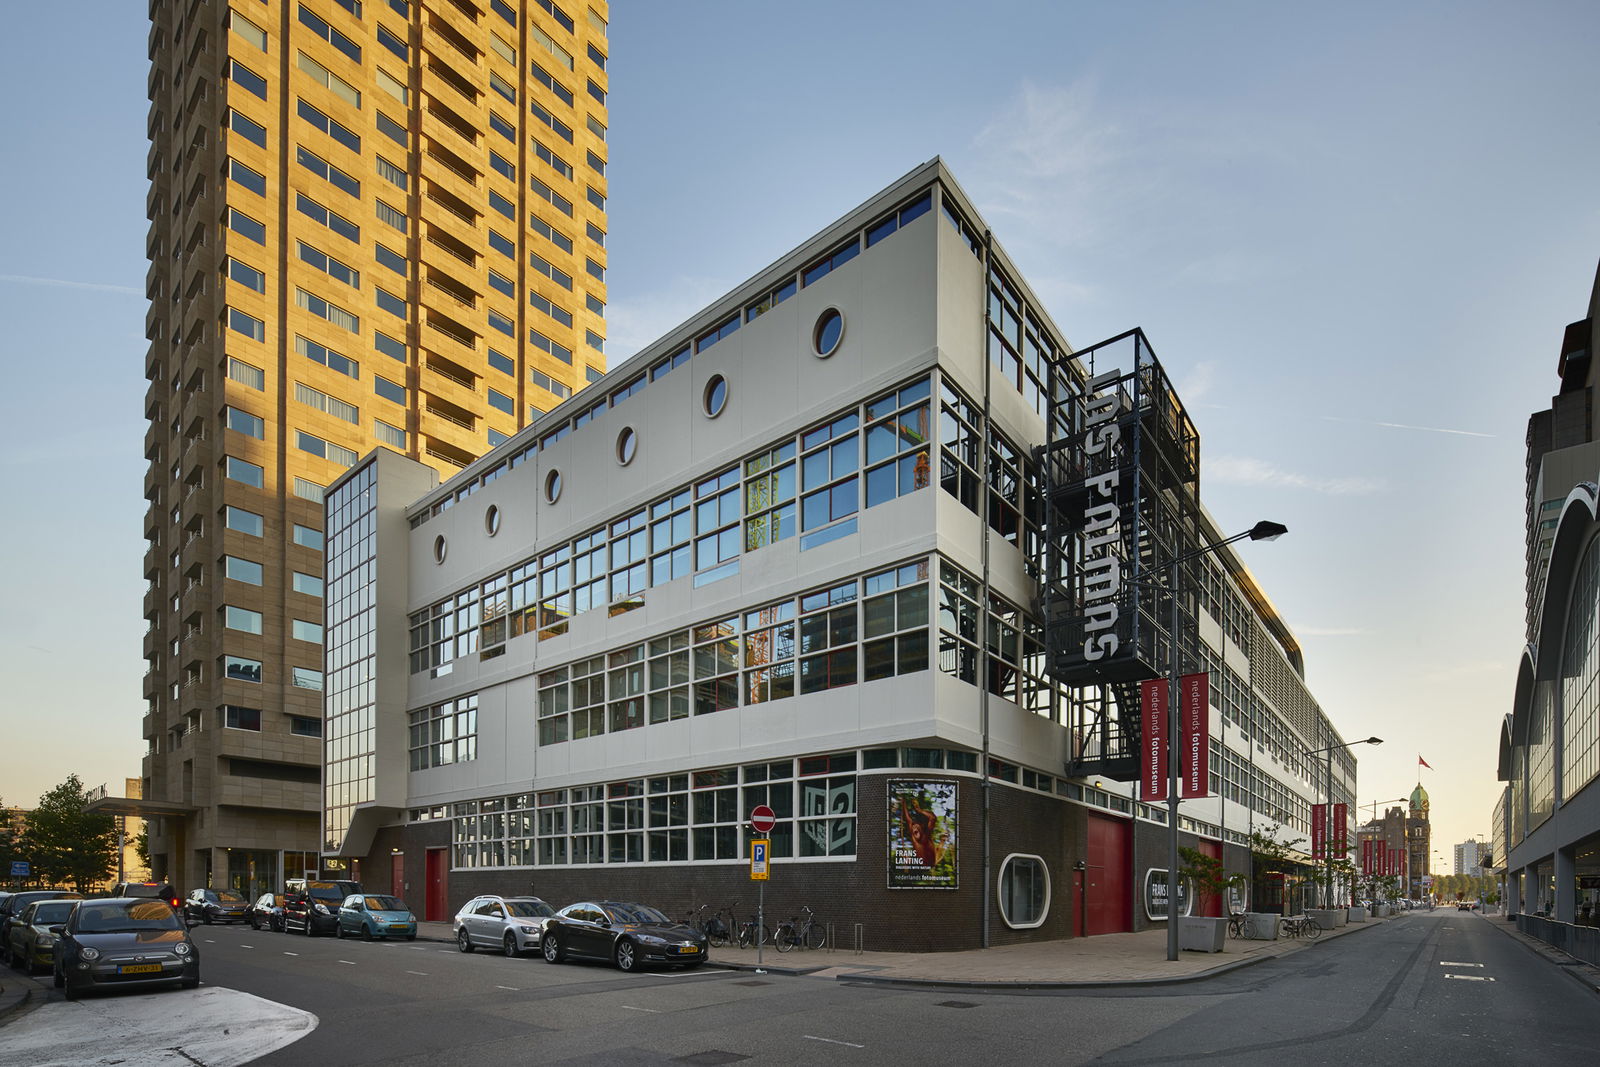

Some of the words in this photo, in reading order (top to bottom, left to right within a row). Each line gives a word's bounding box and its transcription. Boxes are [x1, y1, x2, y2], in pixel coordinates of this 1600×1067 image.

[1085, 368, 1121, 456] LAS
[1084, 469, 1120, 662] PALMAS
[1152, 686, 1160, 735] nederlands
[1192, 680, 1200, 731] nederlands
[1152, 737, 1160, 795] fotomuseum
[1192, 733, 1200, 791] fotomuseum
[756, 846, 763, 861] P
[895, 849, 917, 857] FRANS
[895, 857, 924, 865] LANTING
[1152, 883, 1166, 897] FRANS
